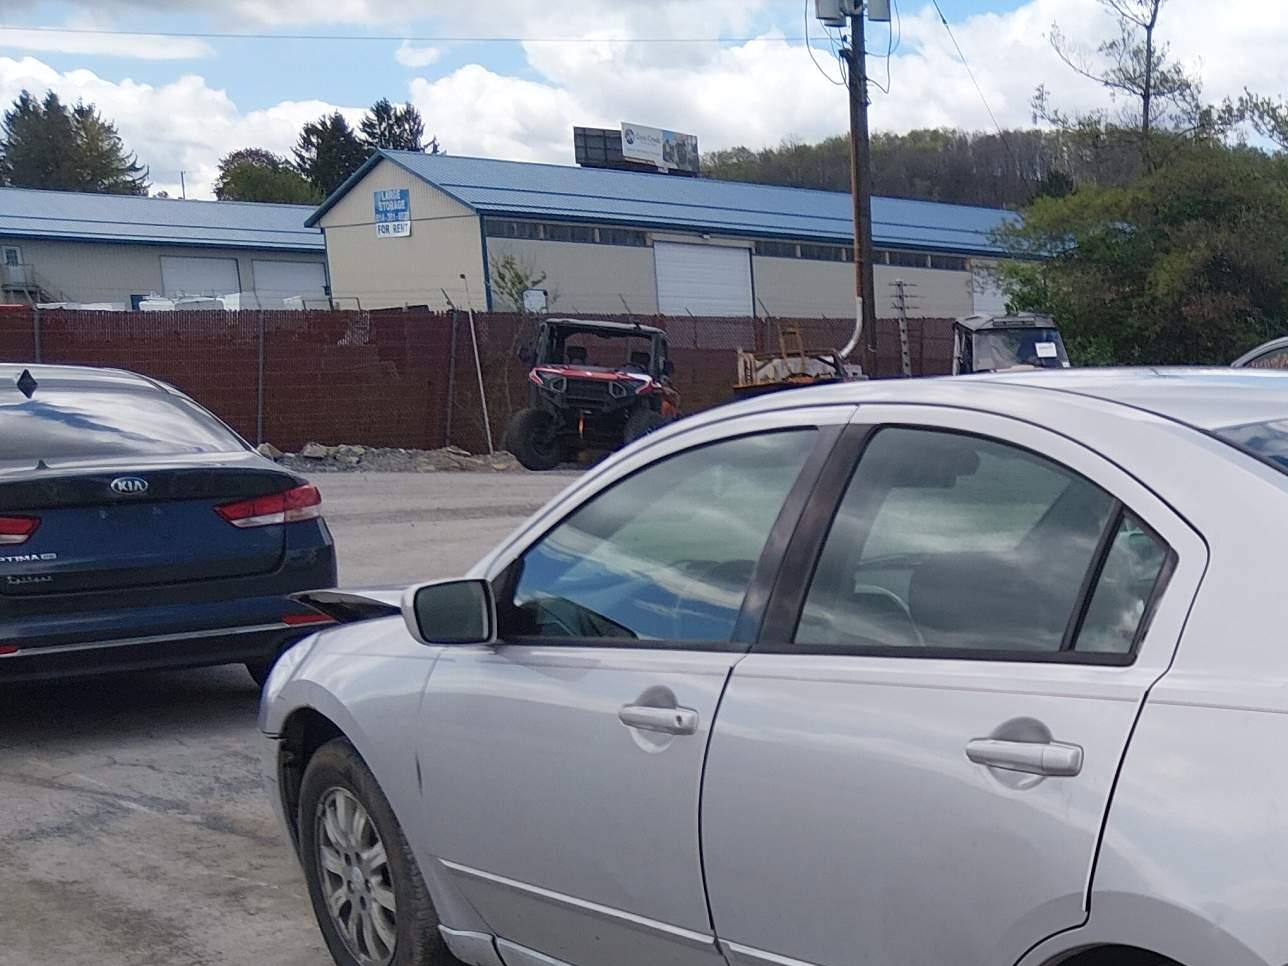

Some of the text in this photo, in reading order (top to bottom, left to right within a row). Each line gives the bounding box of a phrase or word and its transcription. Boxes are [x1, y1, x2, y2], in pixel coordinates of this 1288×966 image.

[379, 199, 405, 211] STORAGE
[378, 223, 408, 234] FOR RENT
